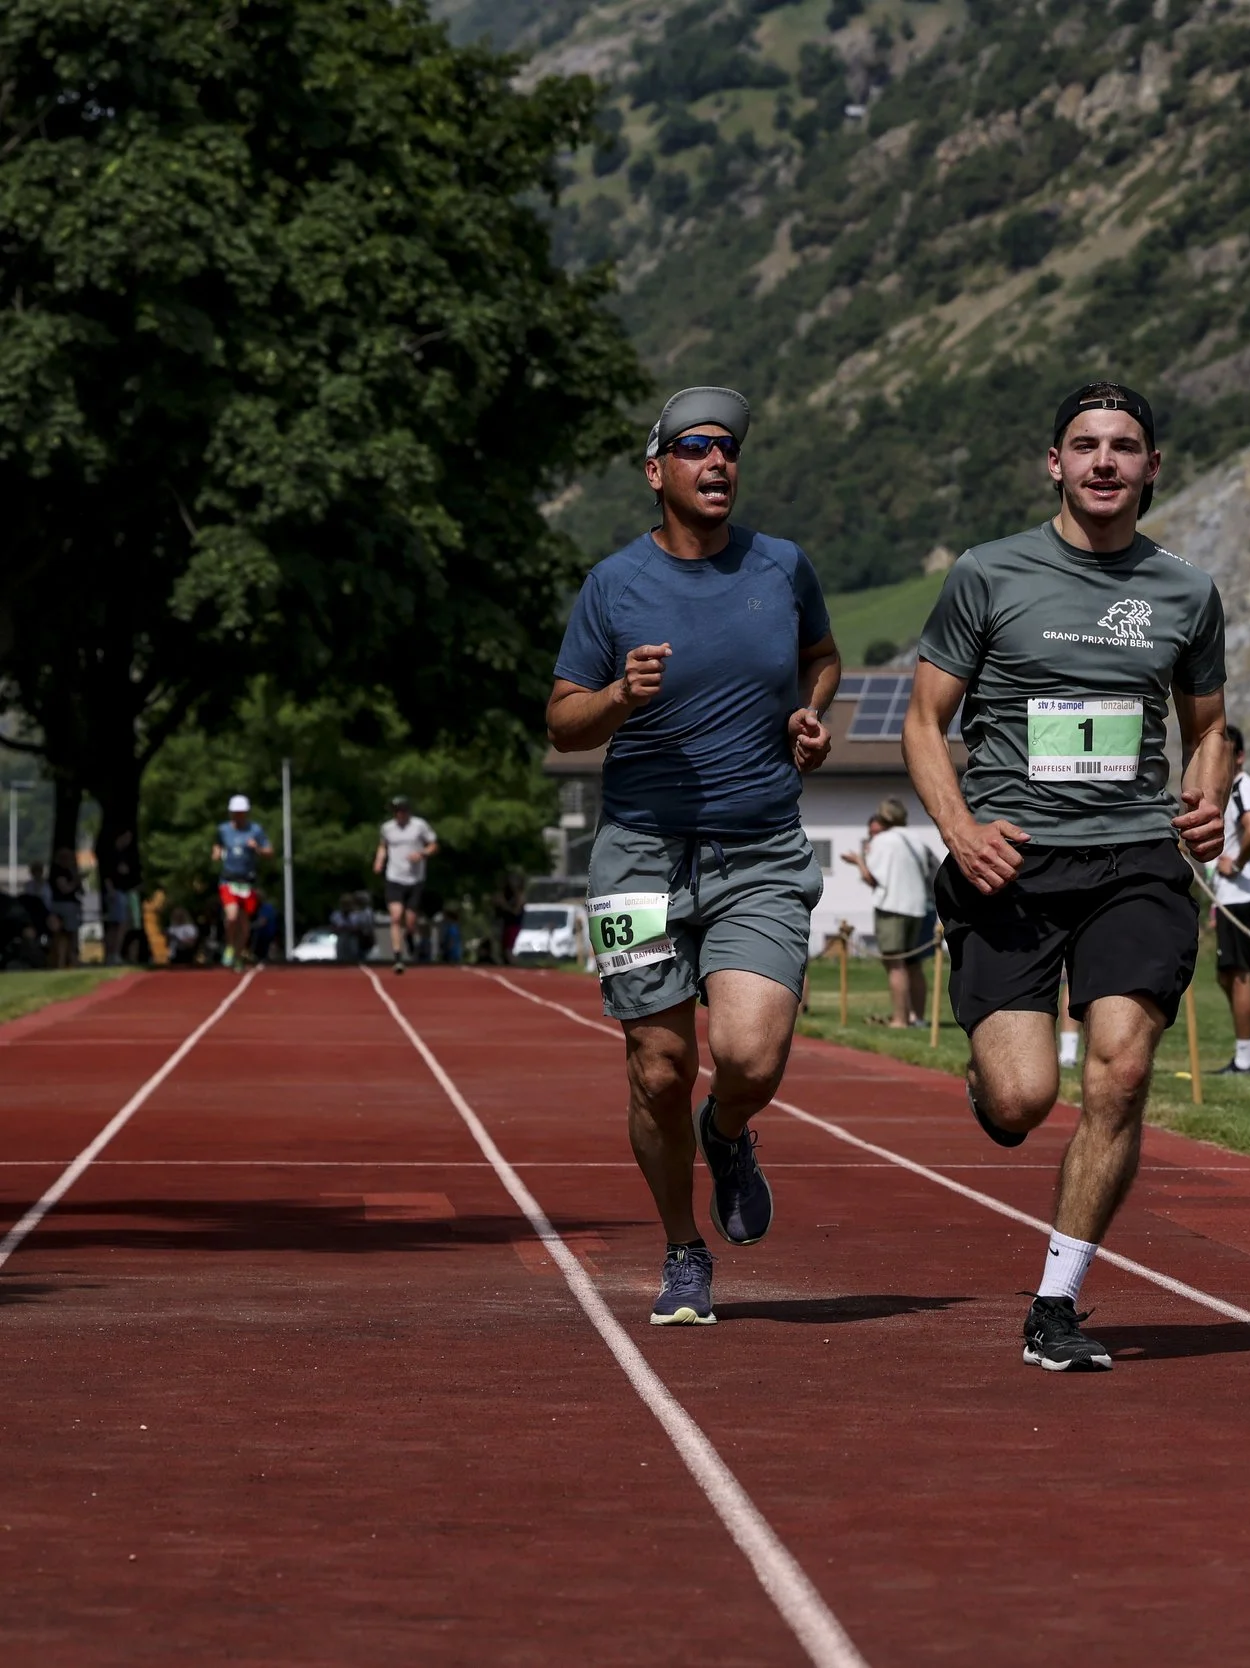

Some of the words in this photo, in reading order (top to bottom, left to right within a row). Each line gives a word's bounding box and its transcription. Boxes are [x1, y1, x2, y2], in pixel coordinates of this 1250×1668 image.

[1042, 630, 1080, 642] GRAND
[1081, 634, 1105, 645] PRIX
[1105, 637, 1128, 647] VON
[1129, 639, 1154, 649] BERN
[1037, 701, 1049, 710] stv
[1057, 701, 1085, 711] gampel
[1078, 718, 1094, 752] 1
[1031, 764, 1072, 773] RAIFFEISEN
[593, 900, 612, 913] gampel
[624, 896, 659, 907] lonzalauf
[600, 914, 634, 949] 63
[633, 942, 671, 960] RAIFFEISEN
